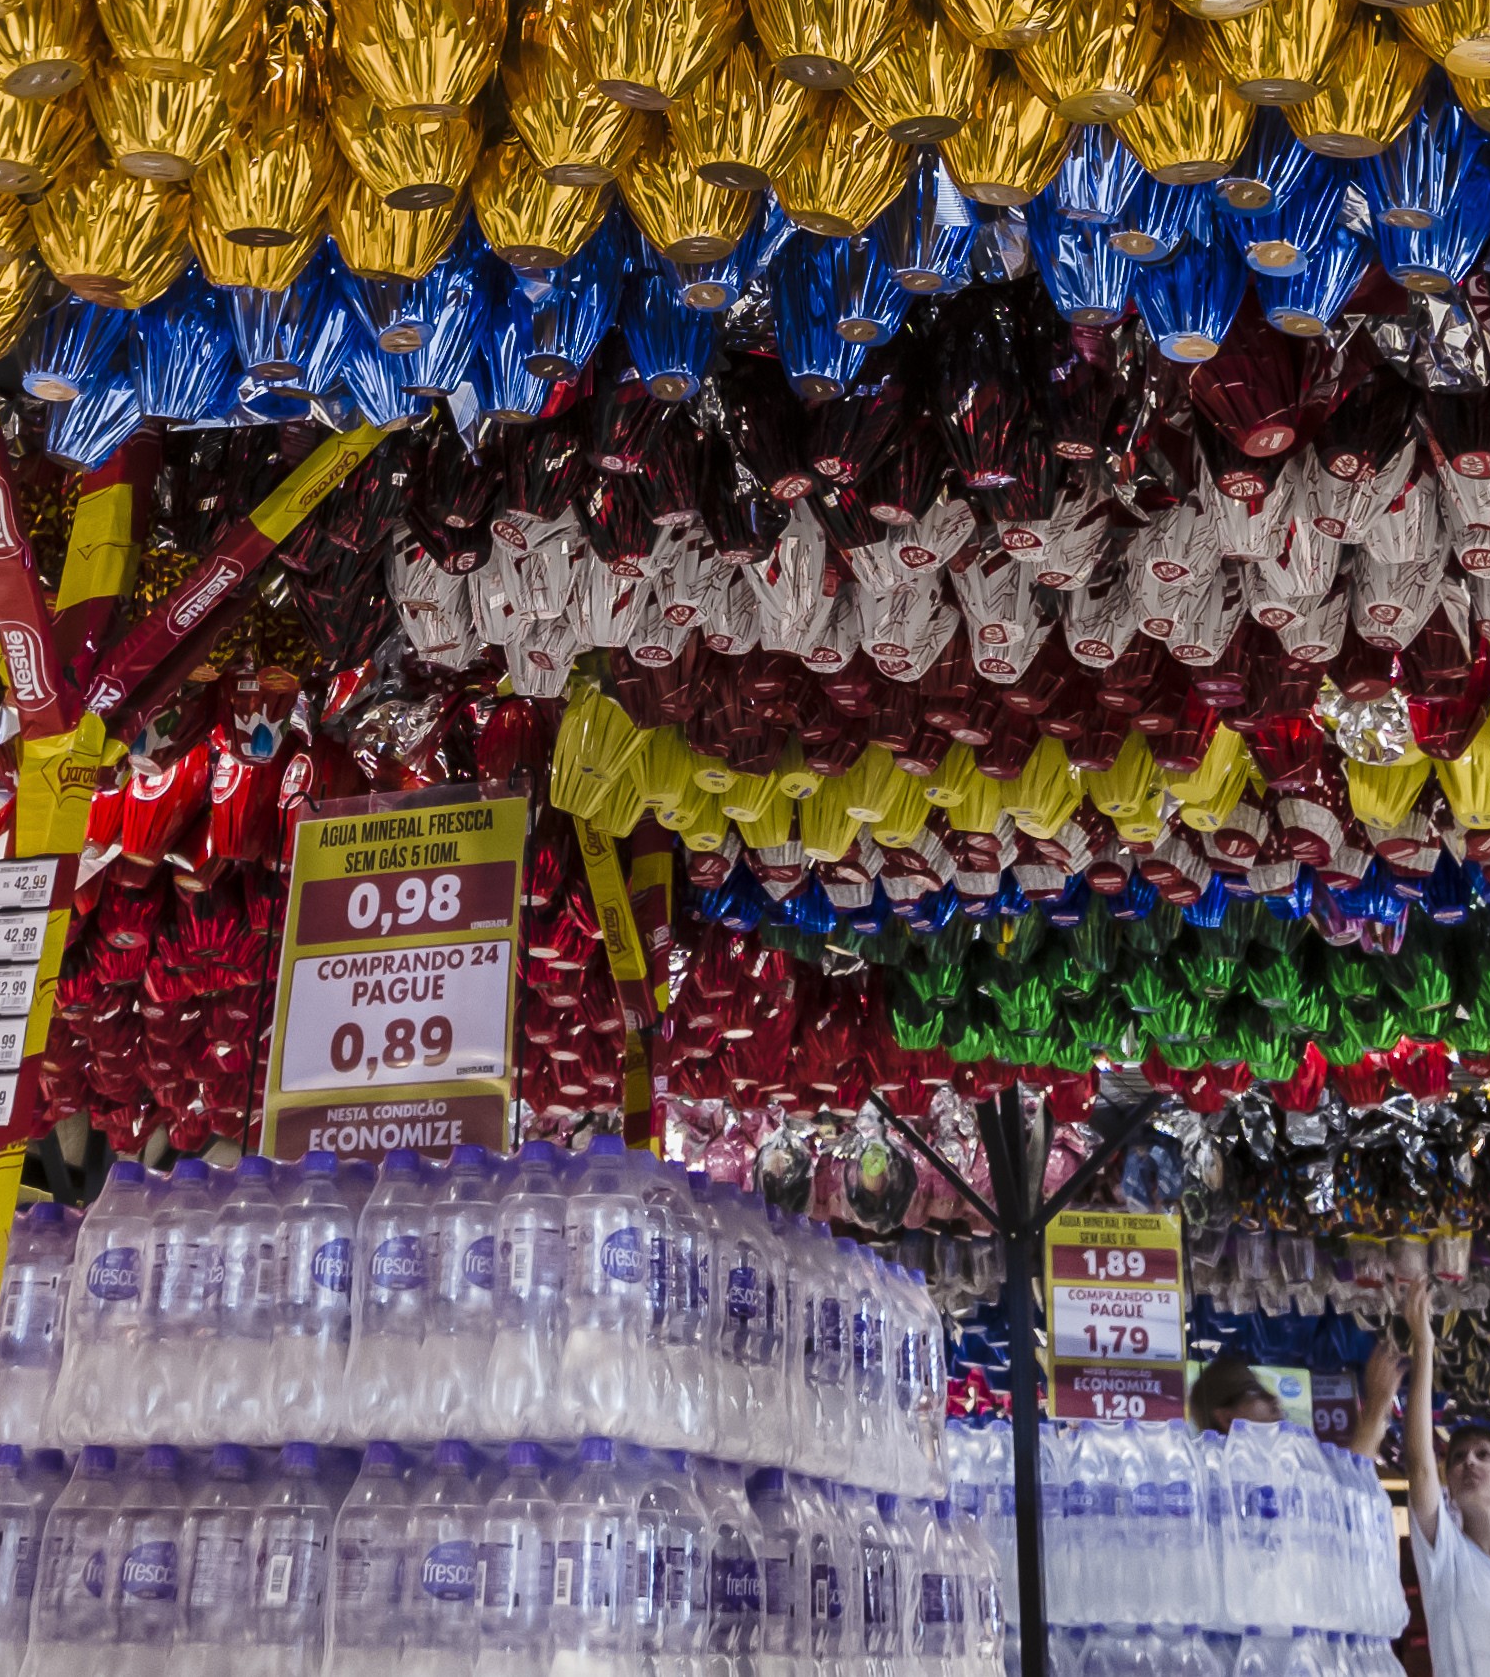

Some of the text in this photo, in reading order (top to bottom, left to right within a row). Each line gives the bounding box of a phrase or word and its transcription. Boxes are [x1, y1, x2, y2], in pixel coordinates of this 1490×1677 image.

[299, 451, 360, 508] Garoto
[176, 565, 238, 628] Nestlé
[4, 630, 46, 700] Nestlé
[319, 809, 494, 849] ÁGUA MINERAL FRESCCA
[345, 852, 375, 873] SEM
[379, 845, 407, 870] GÁS
[347, 874, 462, 935] 0,98
[317, 944, 499, 981] COMPRANDO 24
[351, 974, 445, 1007] PAGUE
[330, 1015, 453, 1081] 0,89
[327, 1100, 447, 1123] NESTA CONDIÇÃO
[310, 1120, 463, 1153] ECONOMIZE
[1082, 1249, 1146, 1280] 1,89
[1068, 1289, 1171, 1304] COMPRANDO 12
[1090, 1303, 1144, 1319] PAGUE
[1083, 1325, 1149, 1358] 1,79
[1073, 1377, 1162, 1395] ECONOMIZE
[1091, 1394, 1146, 1420] 1,20
